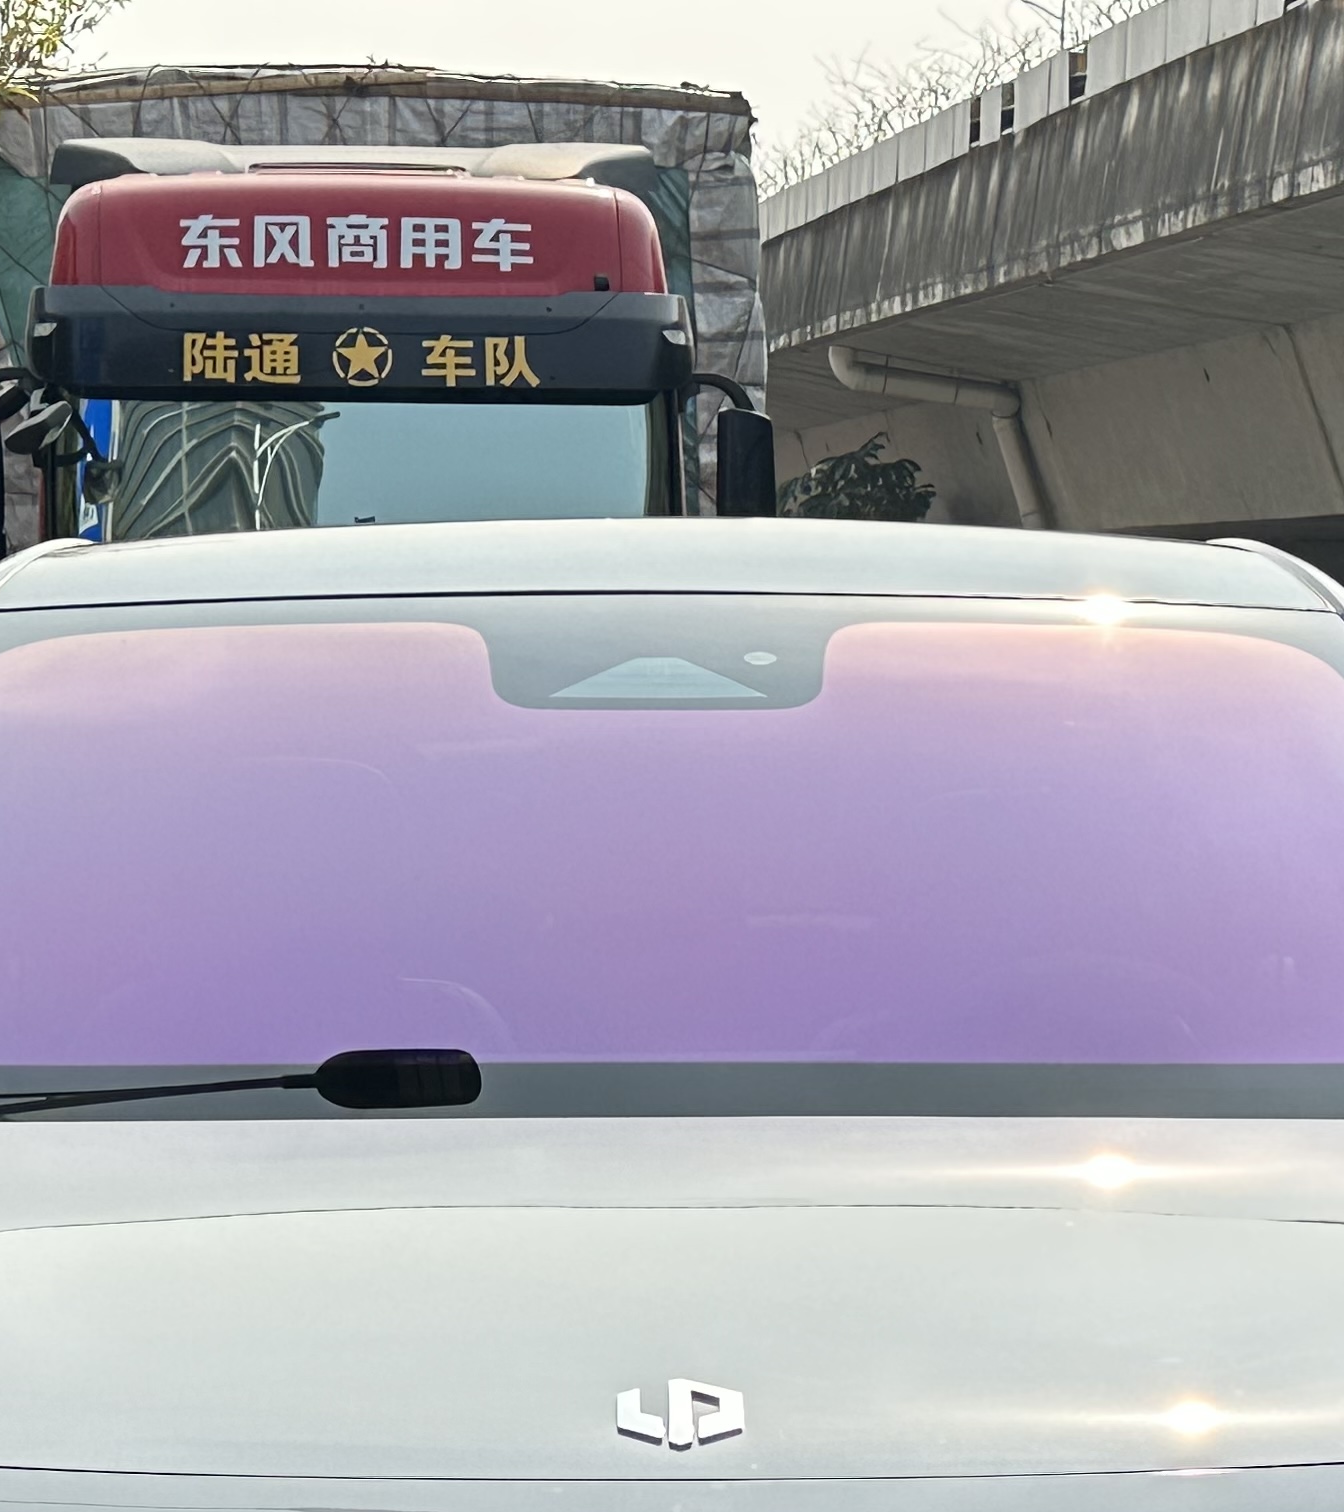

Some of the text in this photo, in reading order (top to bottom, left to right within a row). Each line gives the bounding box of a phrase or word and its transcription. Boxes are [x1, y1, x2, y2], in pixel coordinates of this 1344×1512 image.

[179, 214, 534, 272] 东风商用车
[183, 331, 541, 388] 陆通 车队
